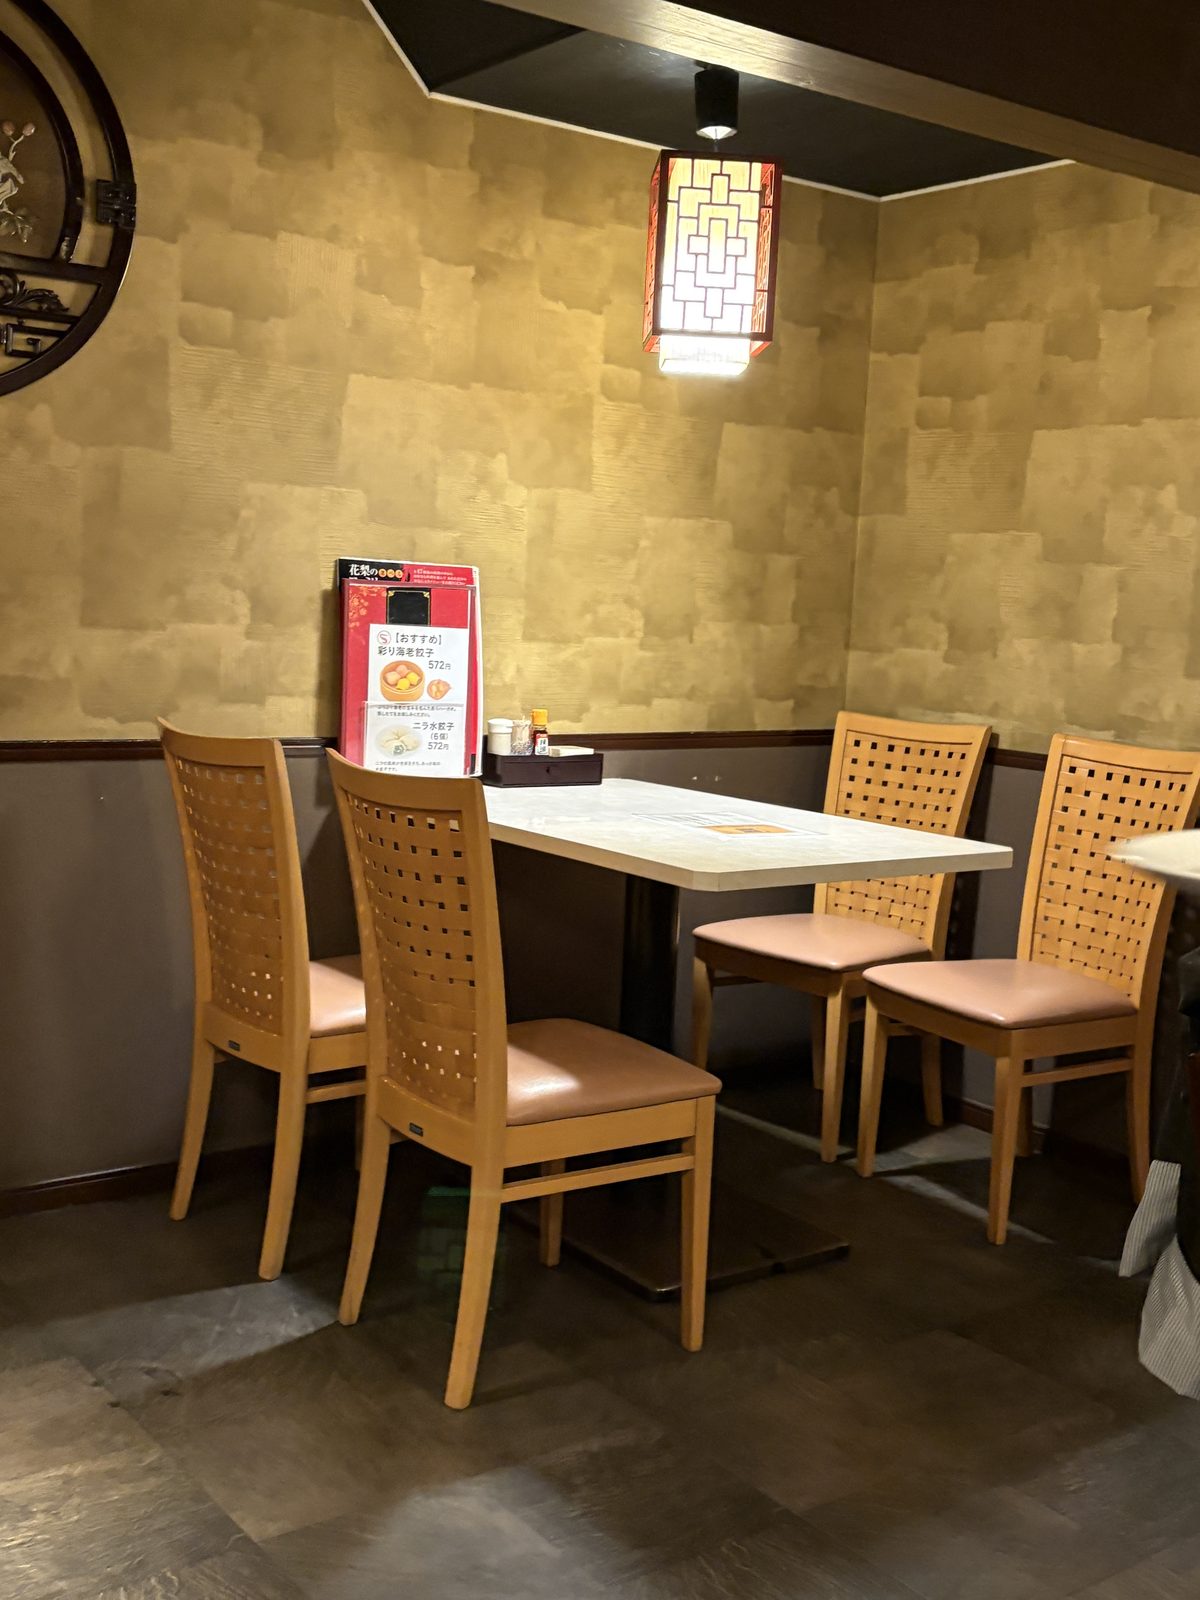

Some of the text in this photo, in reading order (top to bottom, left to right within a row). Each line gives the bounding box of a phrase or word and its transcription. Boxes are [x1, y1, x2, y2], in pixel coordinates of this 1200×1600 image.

[395, 632, 442, 645] 【おすすめ】
[378, 646, 435, 658] 彩り海老餃子
[428, 660, 451, 670] 572円
[412, 722, 455, 731] ニラ水餃子
[427, 741, 449, 750] 572円
